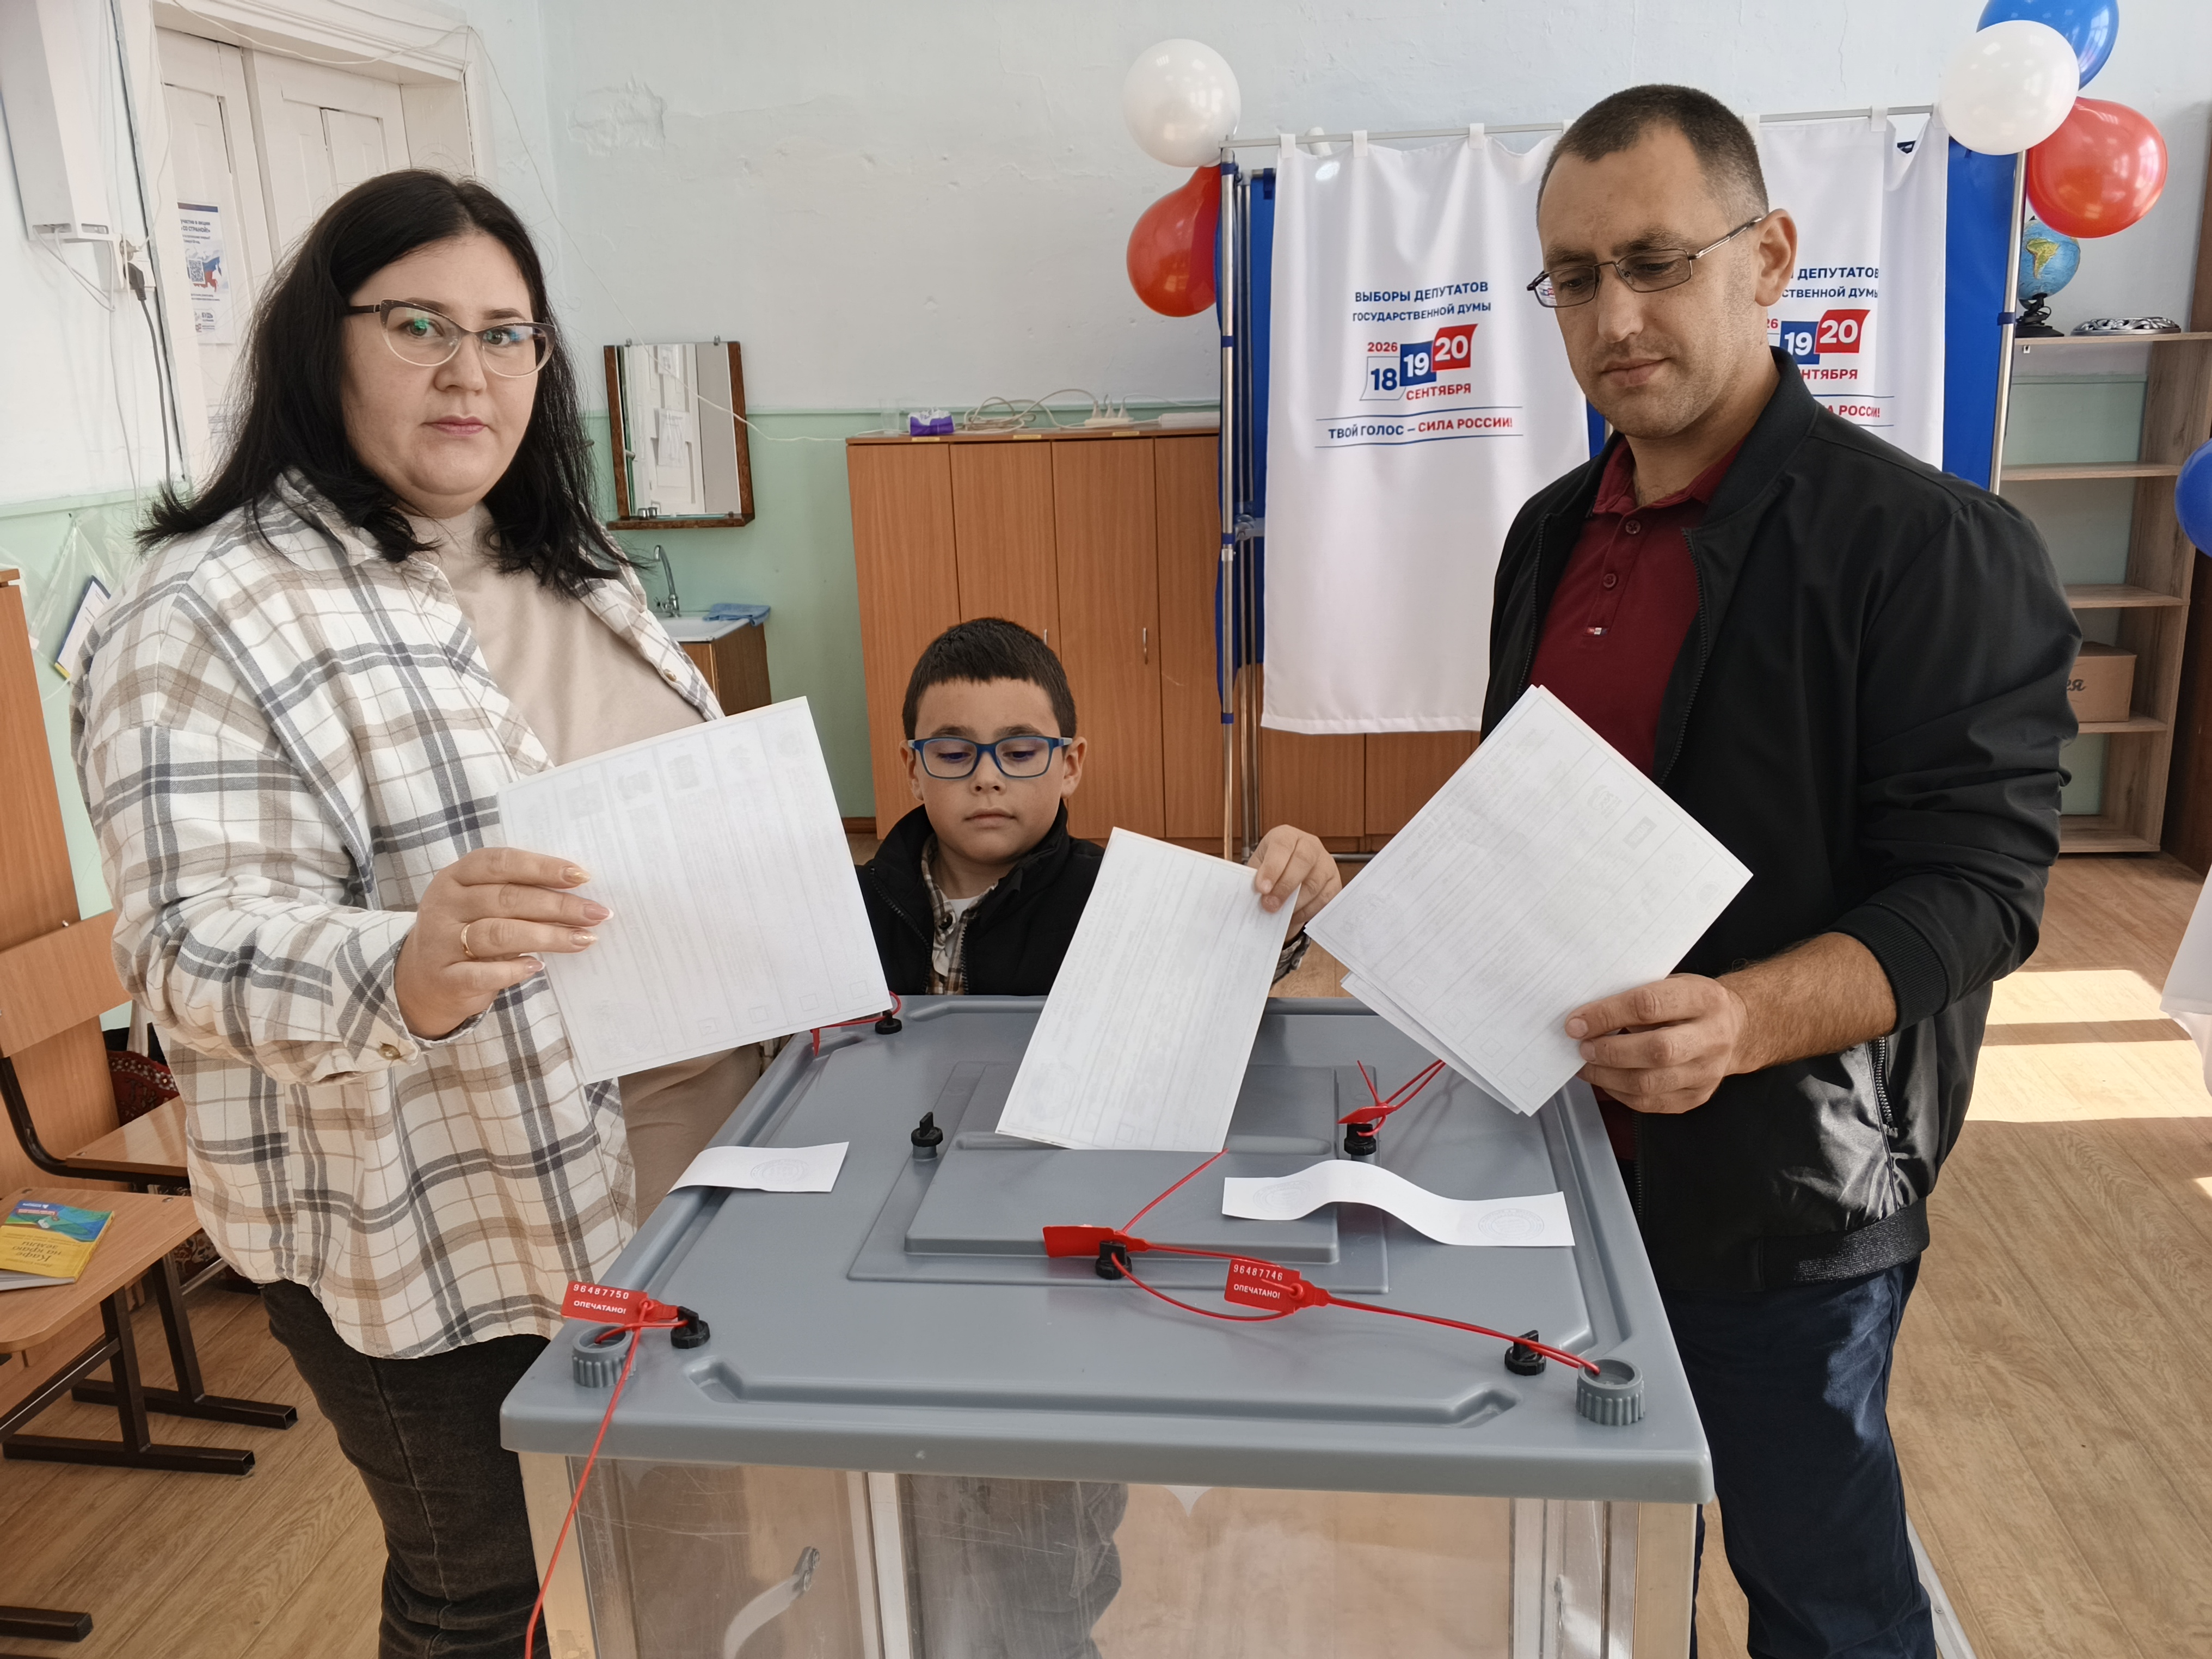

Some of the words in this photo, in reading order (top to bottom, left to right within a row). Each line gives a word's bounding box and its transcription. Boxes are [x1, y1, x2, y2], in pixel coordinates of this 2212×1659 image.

[1797, 266, 1879, 280] ДЕПУТАТОВ
[1355, 291, 1410, 302] ВЫБОРЫ
[1414, 281, 1488, 302] ДЕПУТАТОВ
[1781, 286, 1845, 298] СТВЕННОЙ
[1353, 304, 1454, 322] ГОСУДАРСТВЕННОЙ
[1458, 303, 1491, 314] ДУМЫ
[1784, 331, 1813, 356] 19
[1820, 318, 1859, 344] 20
[1367, 341, 1398, 353] 2026
[1370, 368, 1398, 391] 18
[1403, 352, 1430, 378] 19
[1434, 334, 1469, 362] 20
[1801, 369, 1858, 380] НТЯБРЯ
[1406, 383, 1471, 401] СЕНТЯБРЯ
[1839, 405, 1880, 418] РОССИИ!
[1328, 423, 1359, 439] ТВОЙ
[1360, 425, 1404, 437] ГОЛОС
[1418, 420, 1454, 433] СИЛА
[1457, 416, 1513, 429] РОССИИ!
[21, 1241, 59, 1250] земли
[15, 1252, 52, 1262] Кафе
[1233, 1264, 1283, 1281] 96487746
[573, 1284, 629, 1299] 96487750
[1234, 1283, 1281, 1299] ОПЕЧАТАНО!
[574, 1300, 626, 1314] ОПЕЧАТАНО!
